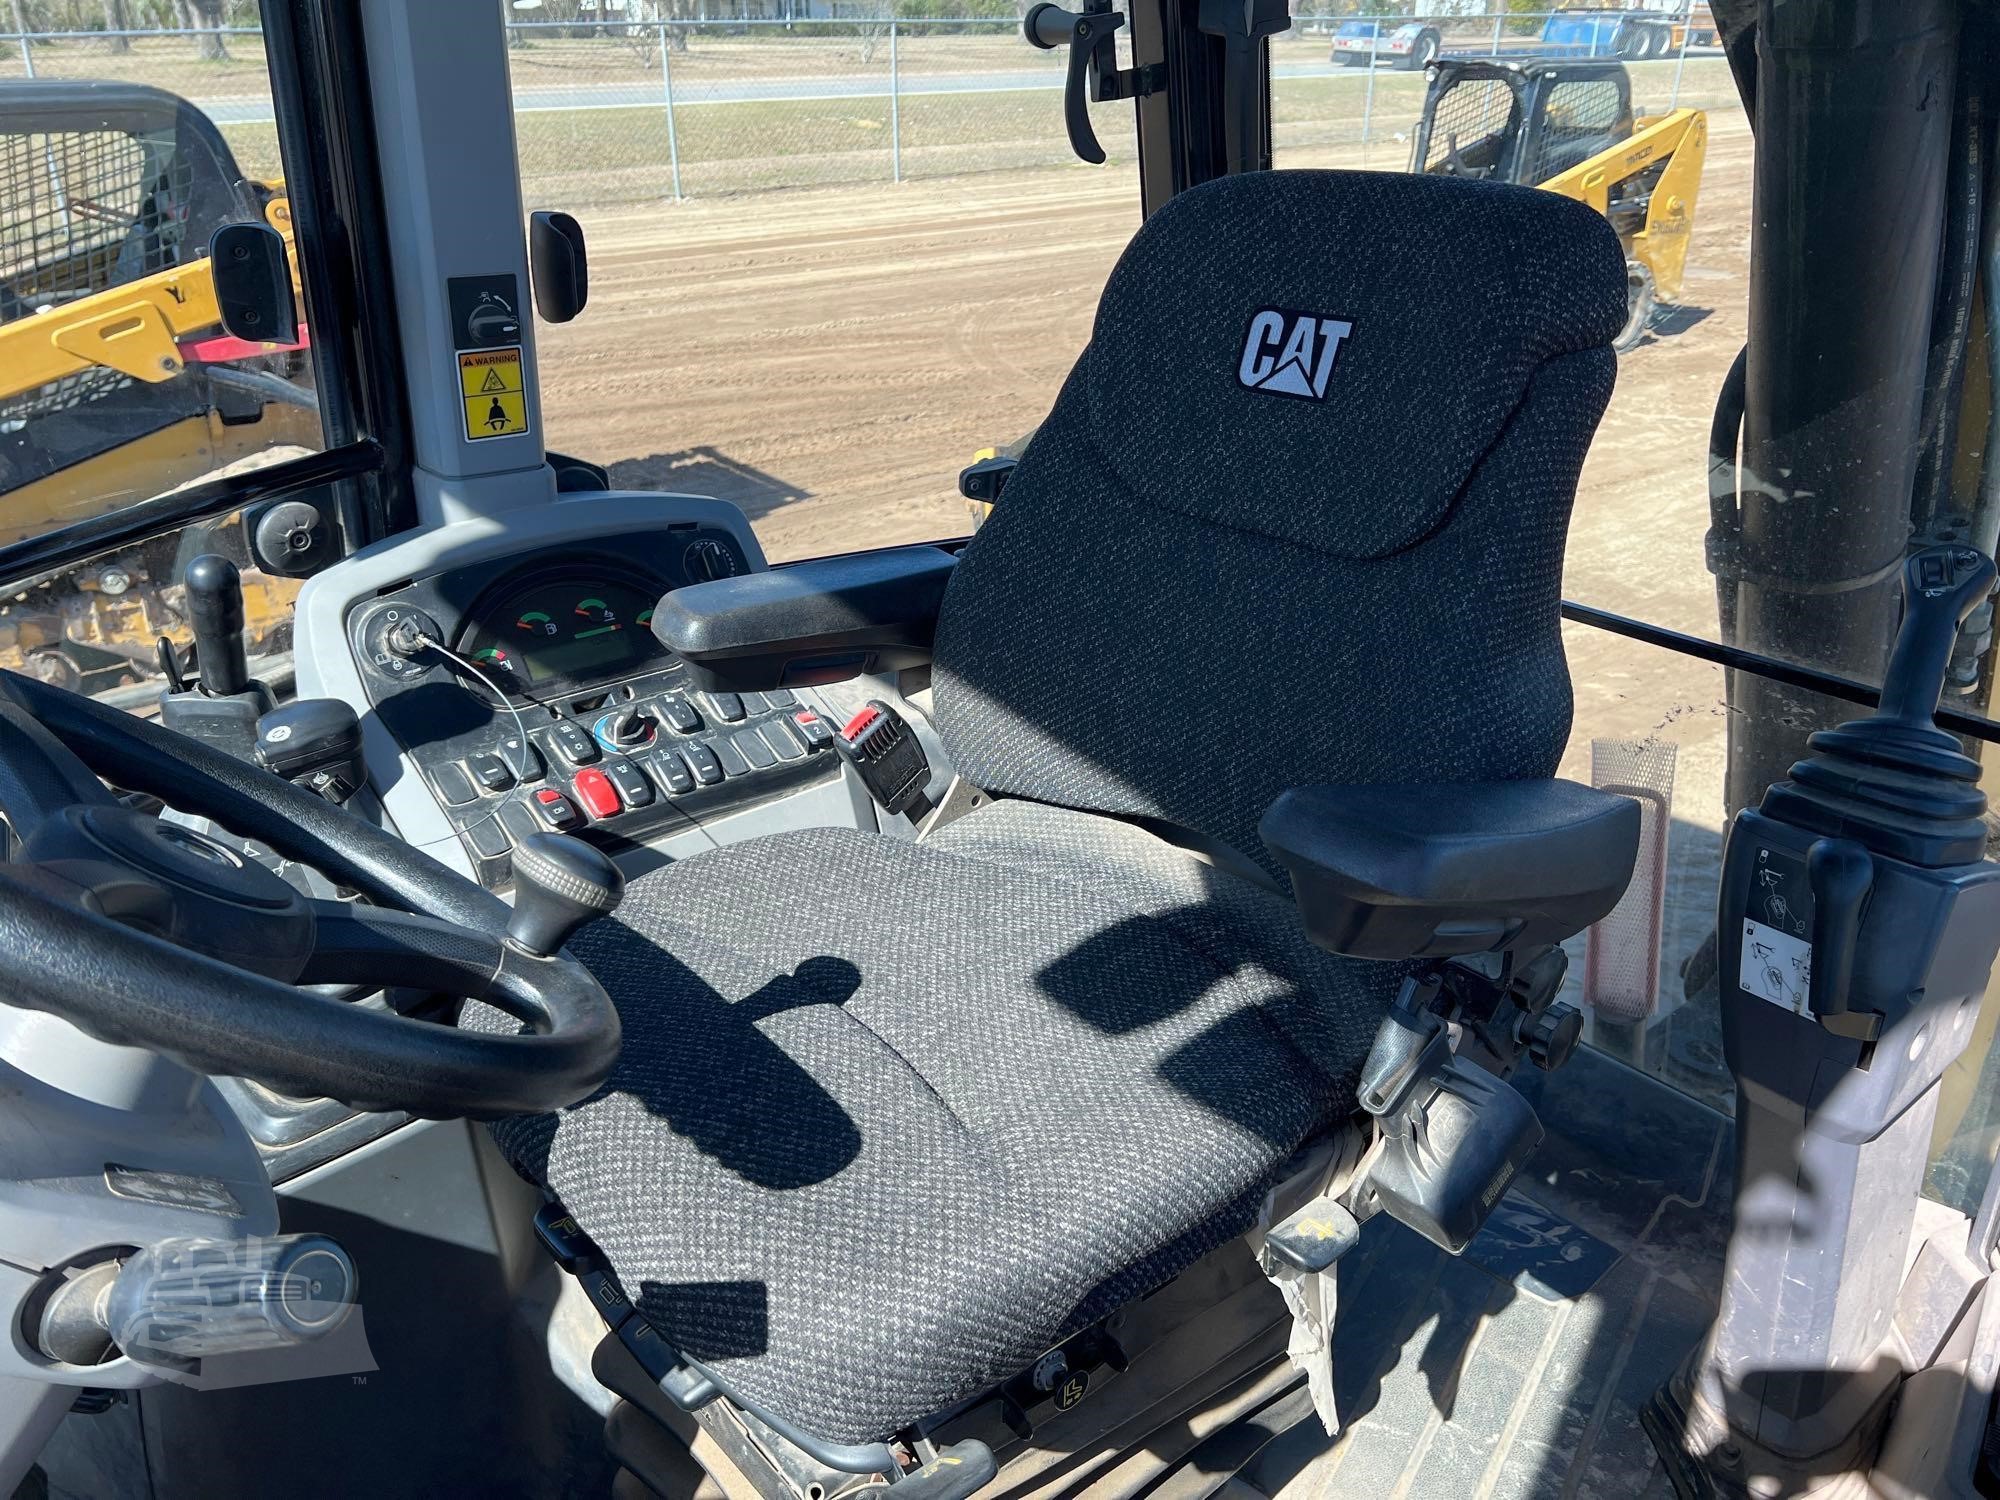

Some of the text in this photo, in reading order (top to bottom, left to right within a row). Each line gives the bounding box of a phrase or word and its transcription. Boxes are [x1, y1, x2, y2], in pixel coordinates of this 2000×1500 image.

[1239, 310, 1353, 398] CAT
[475, 355, 517, 365] WARNING
[813, 726, 821, 734] 2
